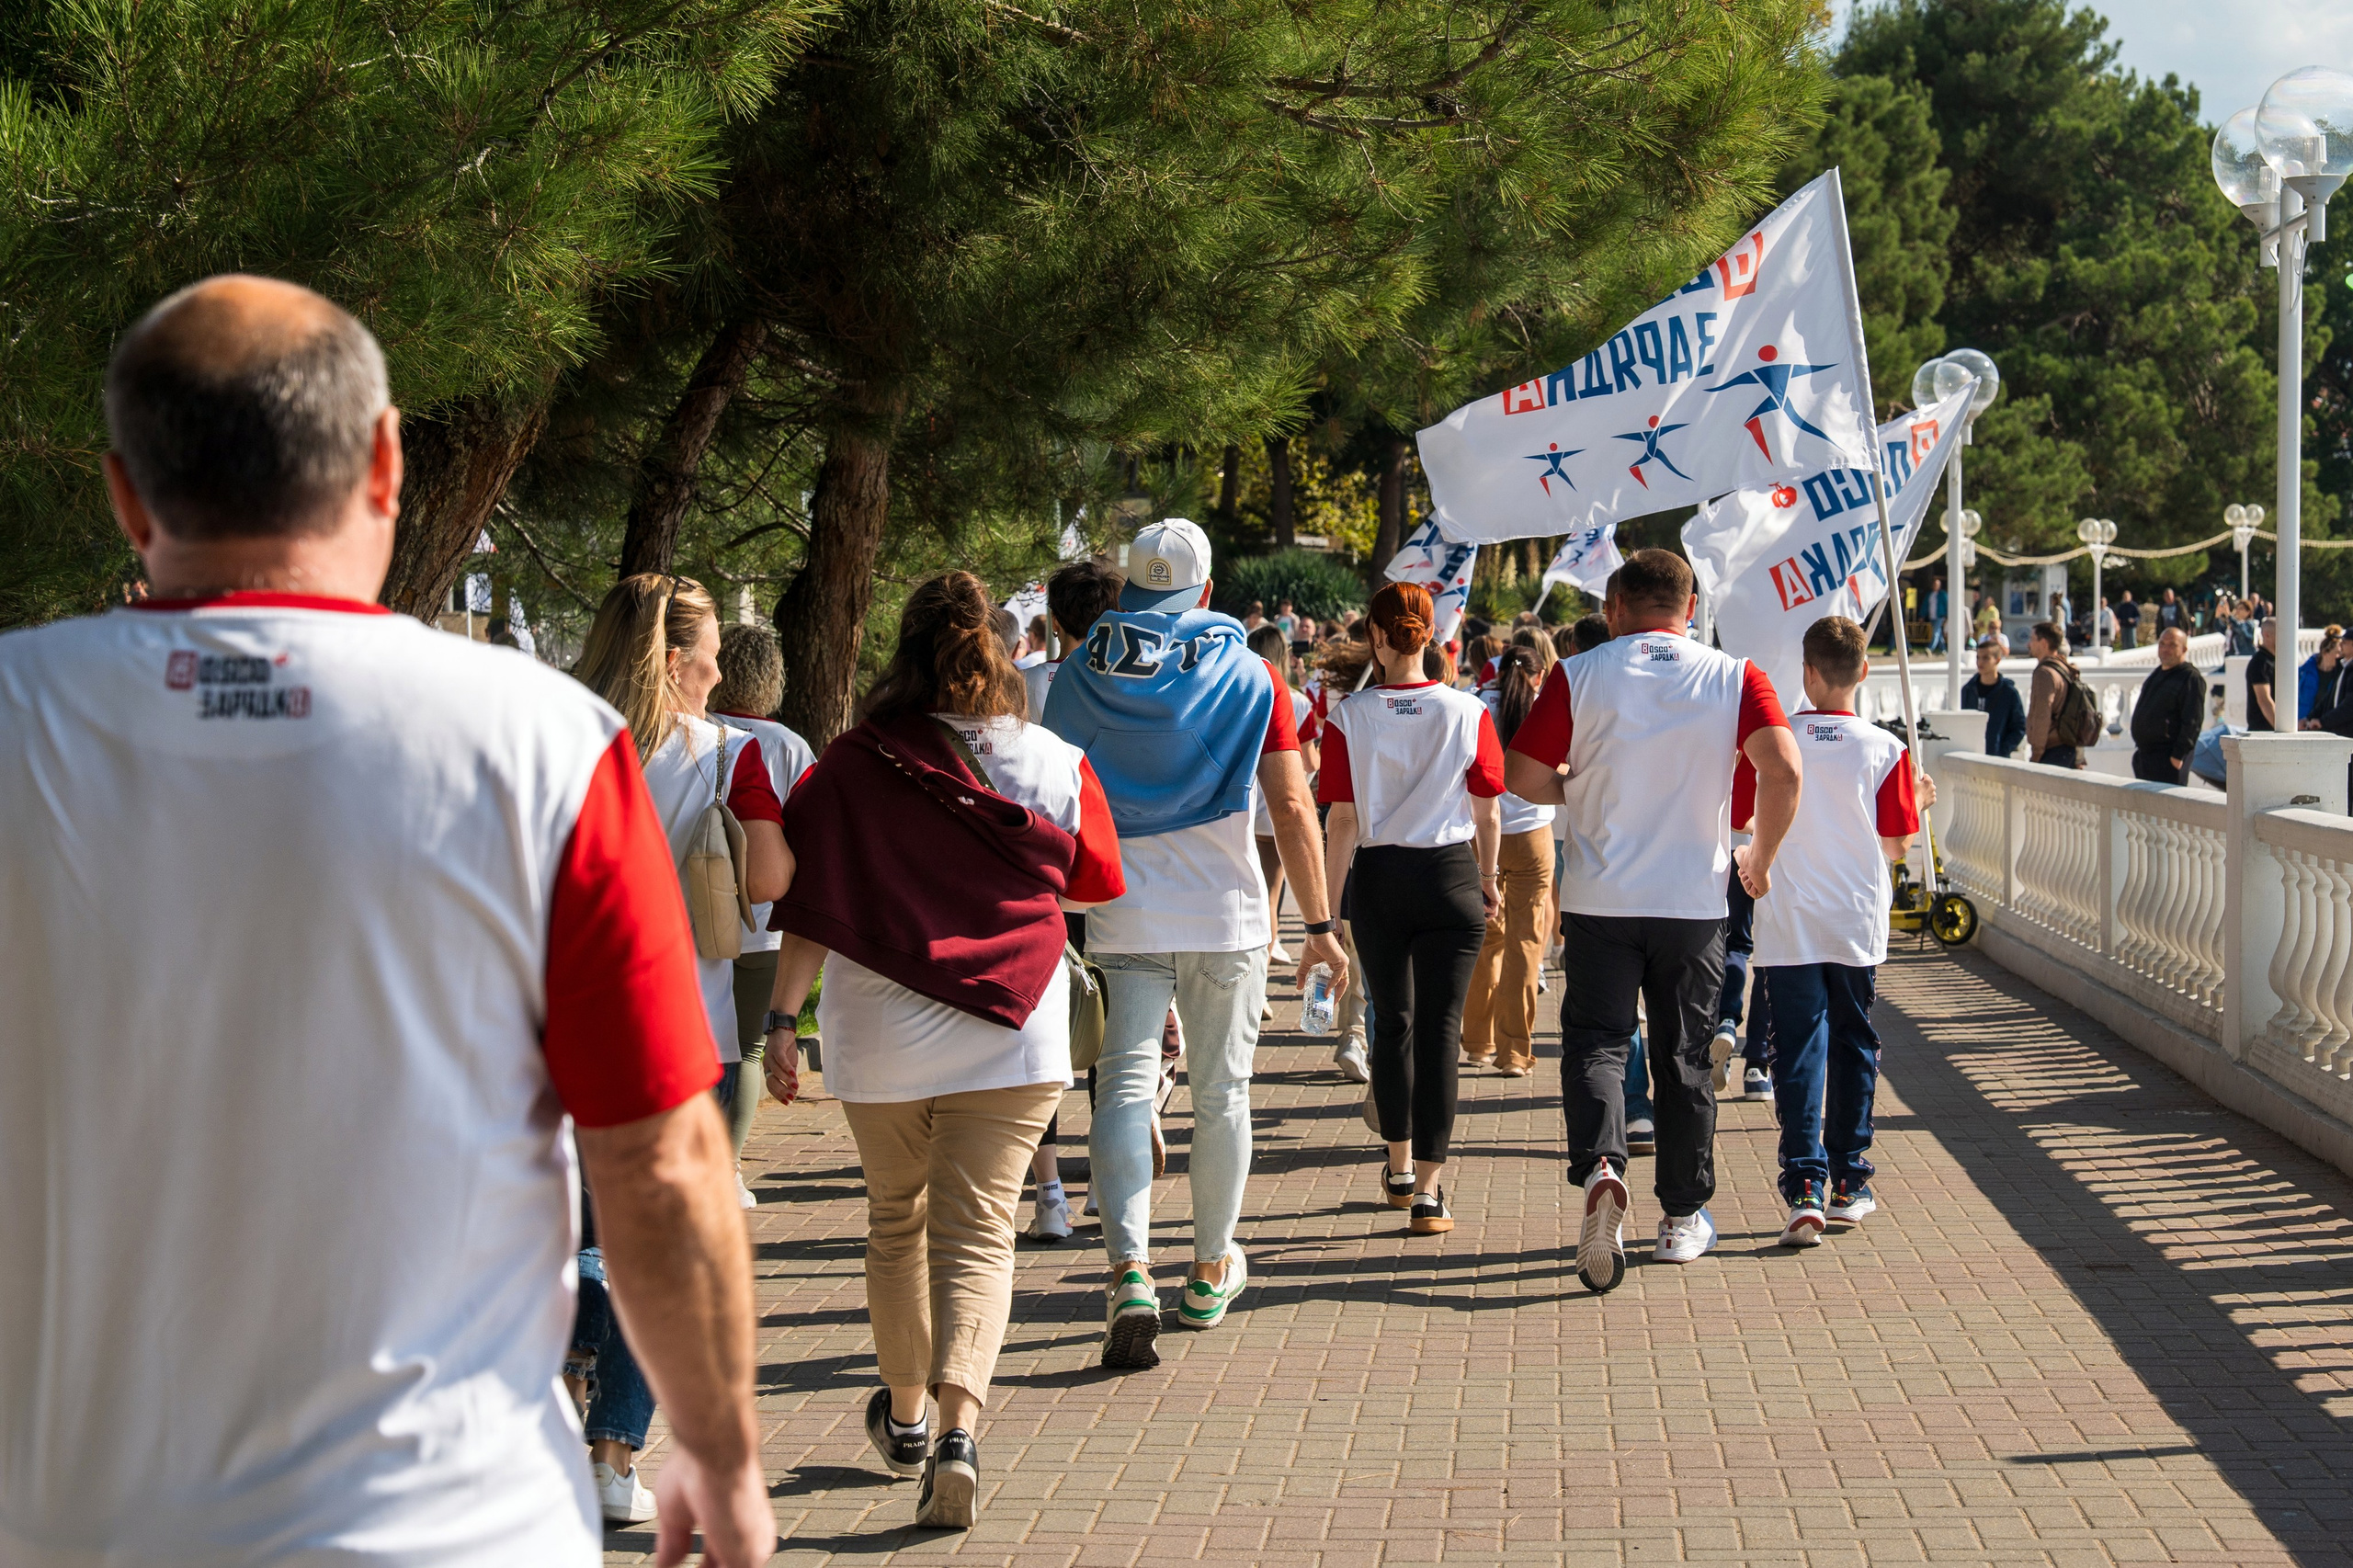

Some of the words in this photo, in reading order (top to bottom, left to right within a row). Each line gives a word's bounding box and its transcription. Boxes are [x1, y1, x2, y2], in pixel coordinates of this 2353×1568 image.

[1642, 643, 1668, 653] BOSCO
[1651, 653, 1679, 662] ЗАРЯДКА
[1387, 699, 1412, 708] BOSCO
[1807, 724, 1833, 734] BOSCO
[949, 1437, 972, 1448] PRADA
